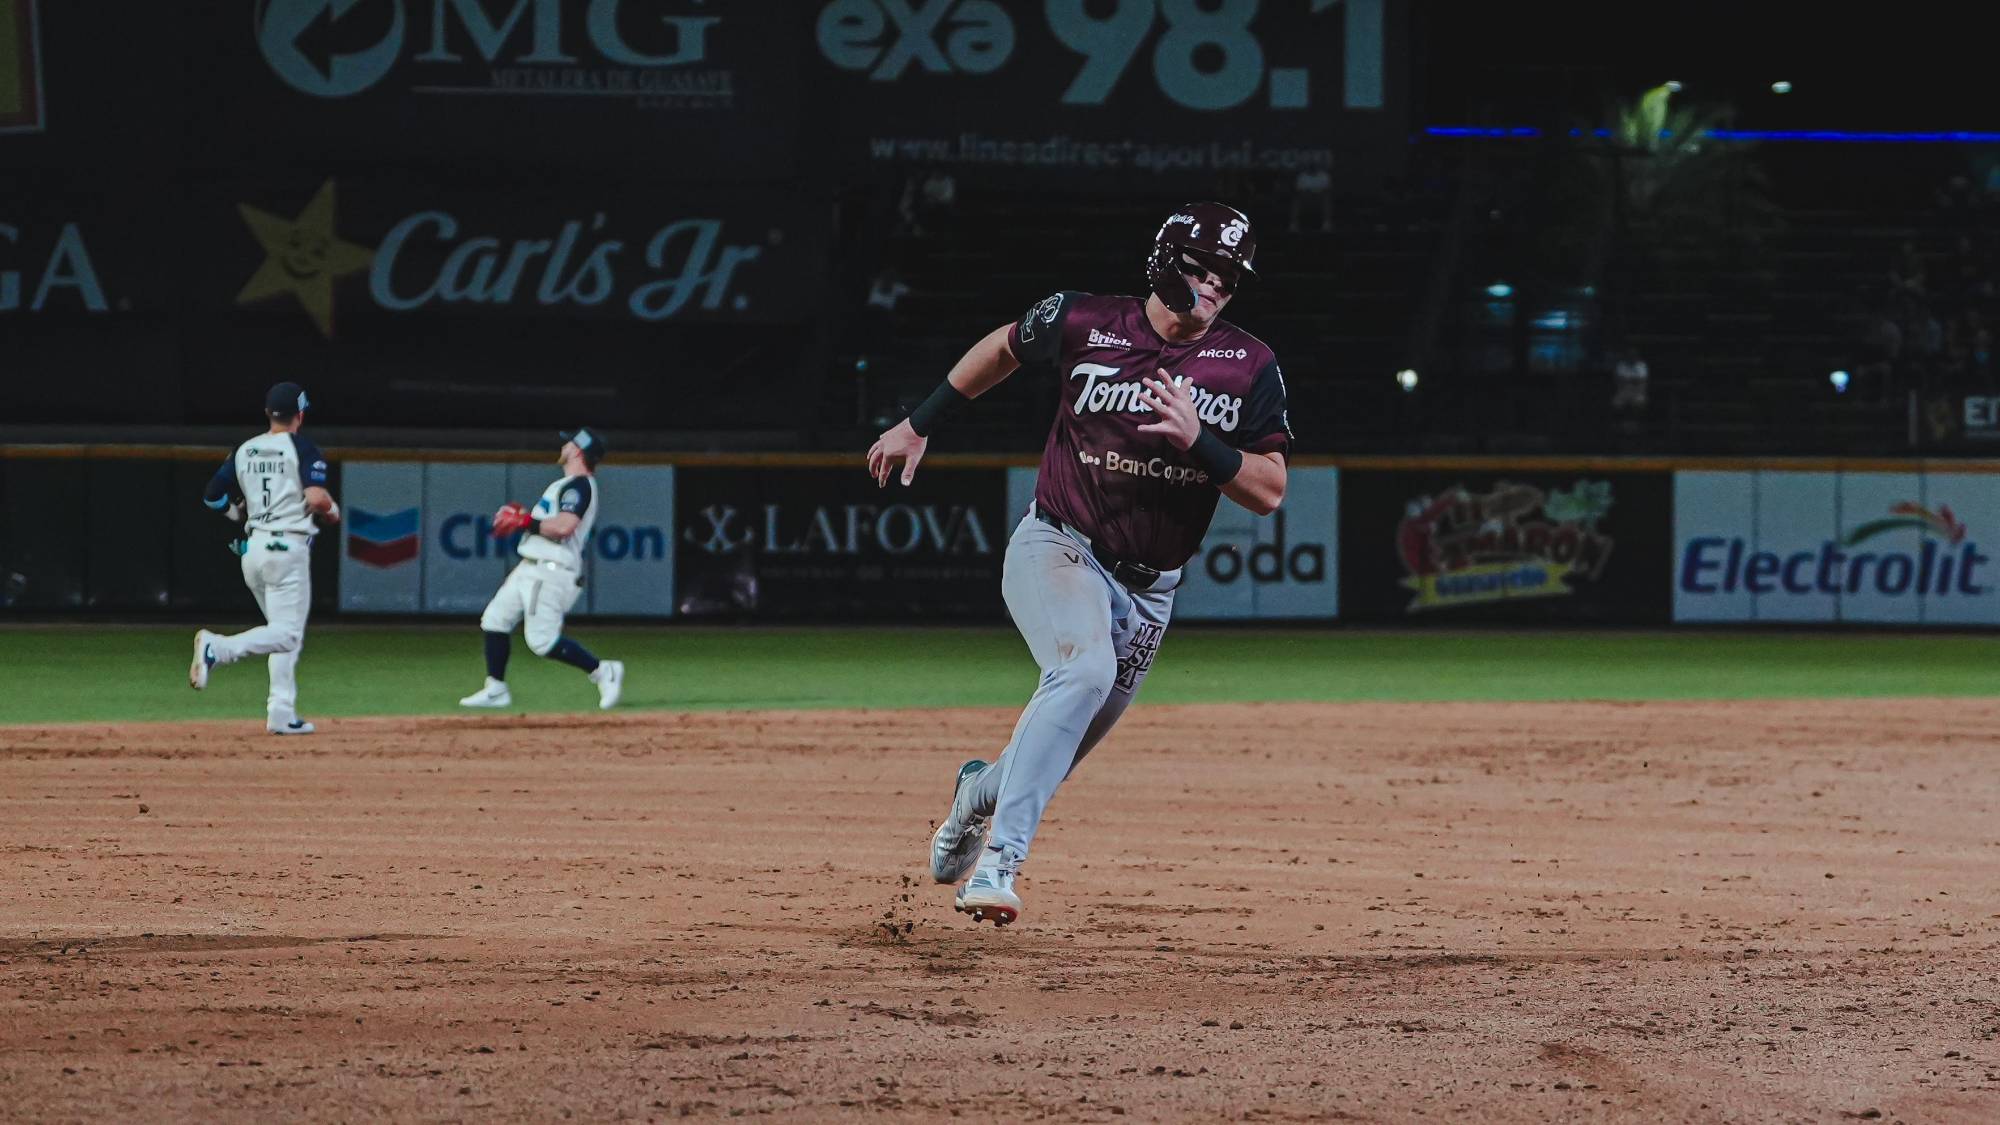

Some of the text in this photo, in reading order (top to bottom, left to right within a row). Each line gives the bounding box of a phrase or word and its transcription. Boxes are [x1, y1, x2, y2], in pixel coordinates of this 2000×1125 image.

[1045, 0, 1386, 112] 98.1
[368, 210, 761, 322] Carl's Jr.
[1197, 348, 1234, 359] ARCO
[262, 477, 271, 508] 5
[1105, 450, 1209, 486] BanCoppe
[438, 513, 665, 561] Chon
[763, 504, 992, 555] LAFOVA
[1195, 503, 1326, 583] oda
[1681, 537, 1987, 596] Electrolit
